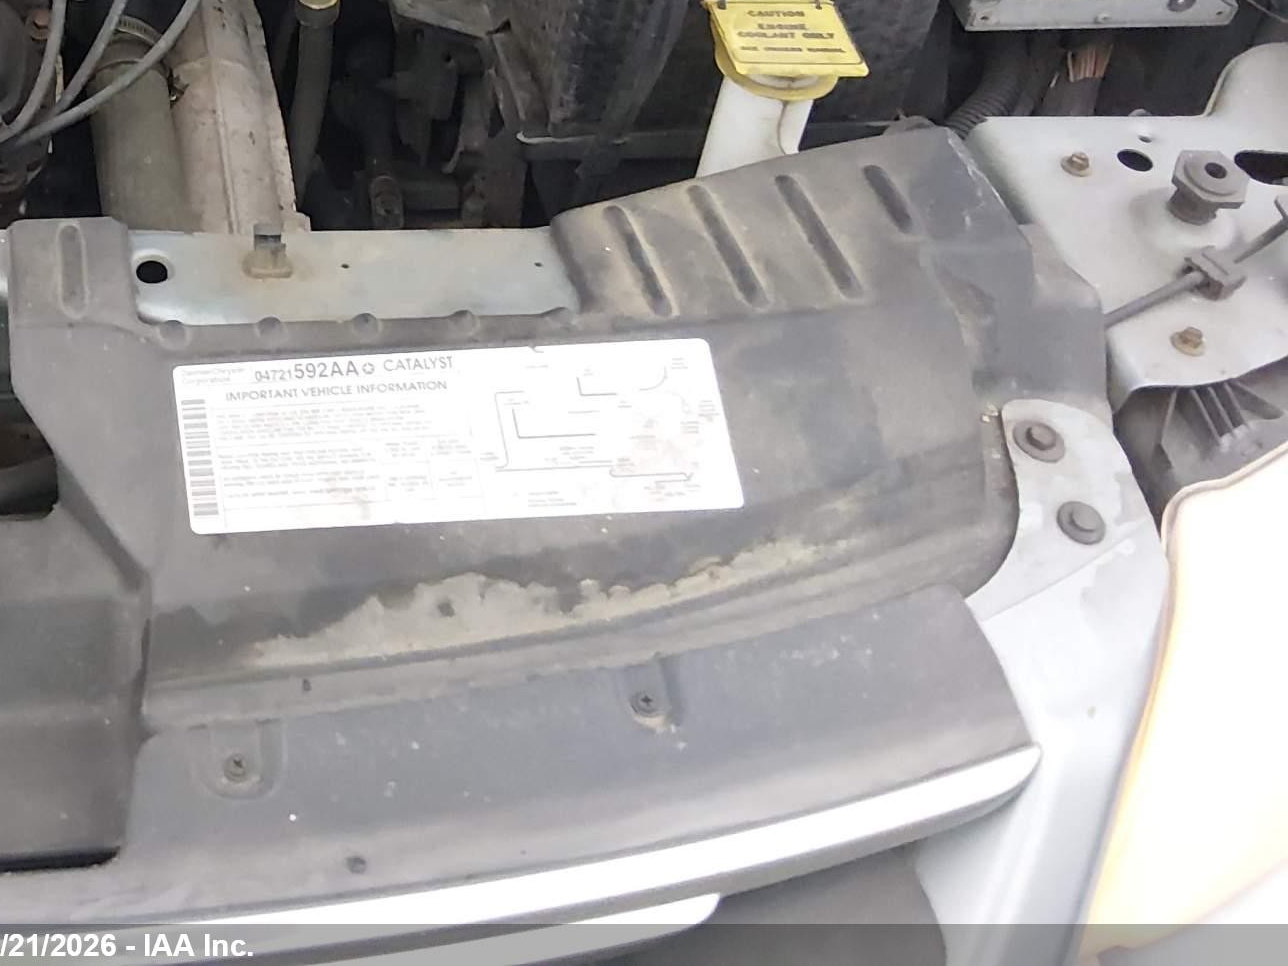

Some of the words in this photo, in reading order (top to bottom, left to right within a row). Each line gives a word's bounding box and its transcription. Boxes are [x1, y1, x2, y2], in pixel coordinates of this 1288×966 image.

[746, 10, 806, 18] CAUTION
[253, 359, 360, 383] 04721592AA
[382, 355, 454, 372] CATALYST
[224, 387, 299, 403] IMPORTANT
[300, 383, 353, 398] VEHICLE
[356, 379, 448, 395] INFORMATION
